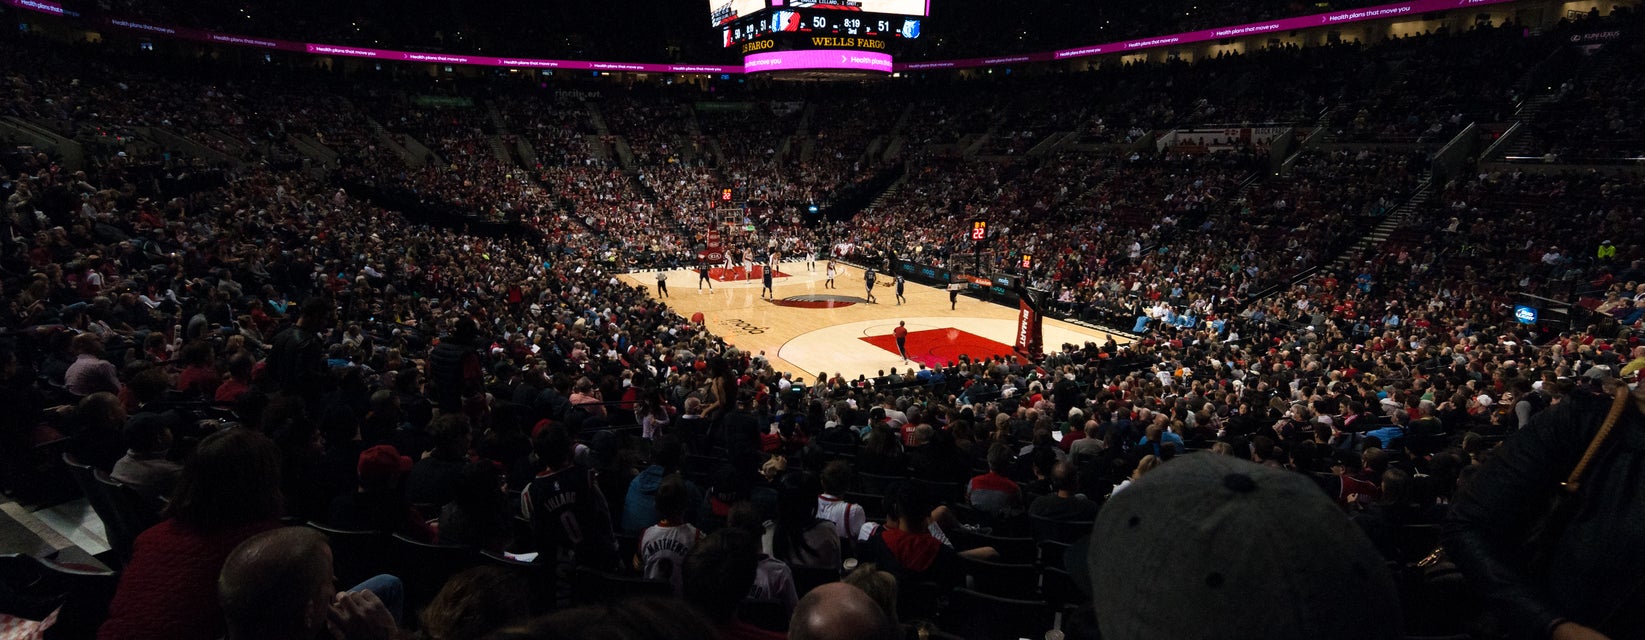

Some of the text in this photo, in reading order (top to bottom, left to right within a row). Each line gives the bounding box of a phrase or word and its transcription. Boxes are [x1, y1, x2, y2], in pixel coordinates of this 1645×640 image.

[1330, 13, 1348, 22] Health
[1349, 12, 1366, 20] plans
[1398, 6, 1412, 14] you
[813, 16, 826, 28] 50
[844, 18, 860, 28] 8:19
[878, 20, 890, 32] 51
[1217, 28, 1232, 36] Health
[748, 40, 774, 52] FARGO
[812, 38, 886, 49] WELLS FARGO
[770, 58, 782, 66] you
[851, 56, 871, 64] Health
[973, 228, 984, 240] 22
[1020, 309, 1029, 348] BI-MART
[560, 511, 584, 544] 0
[648, 538, 688, 556] MATTHEWS
